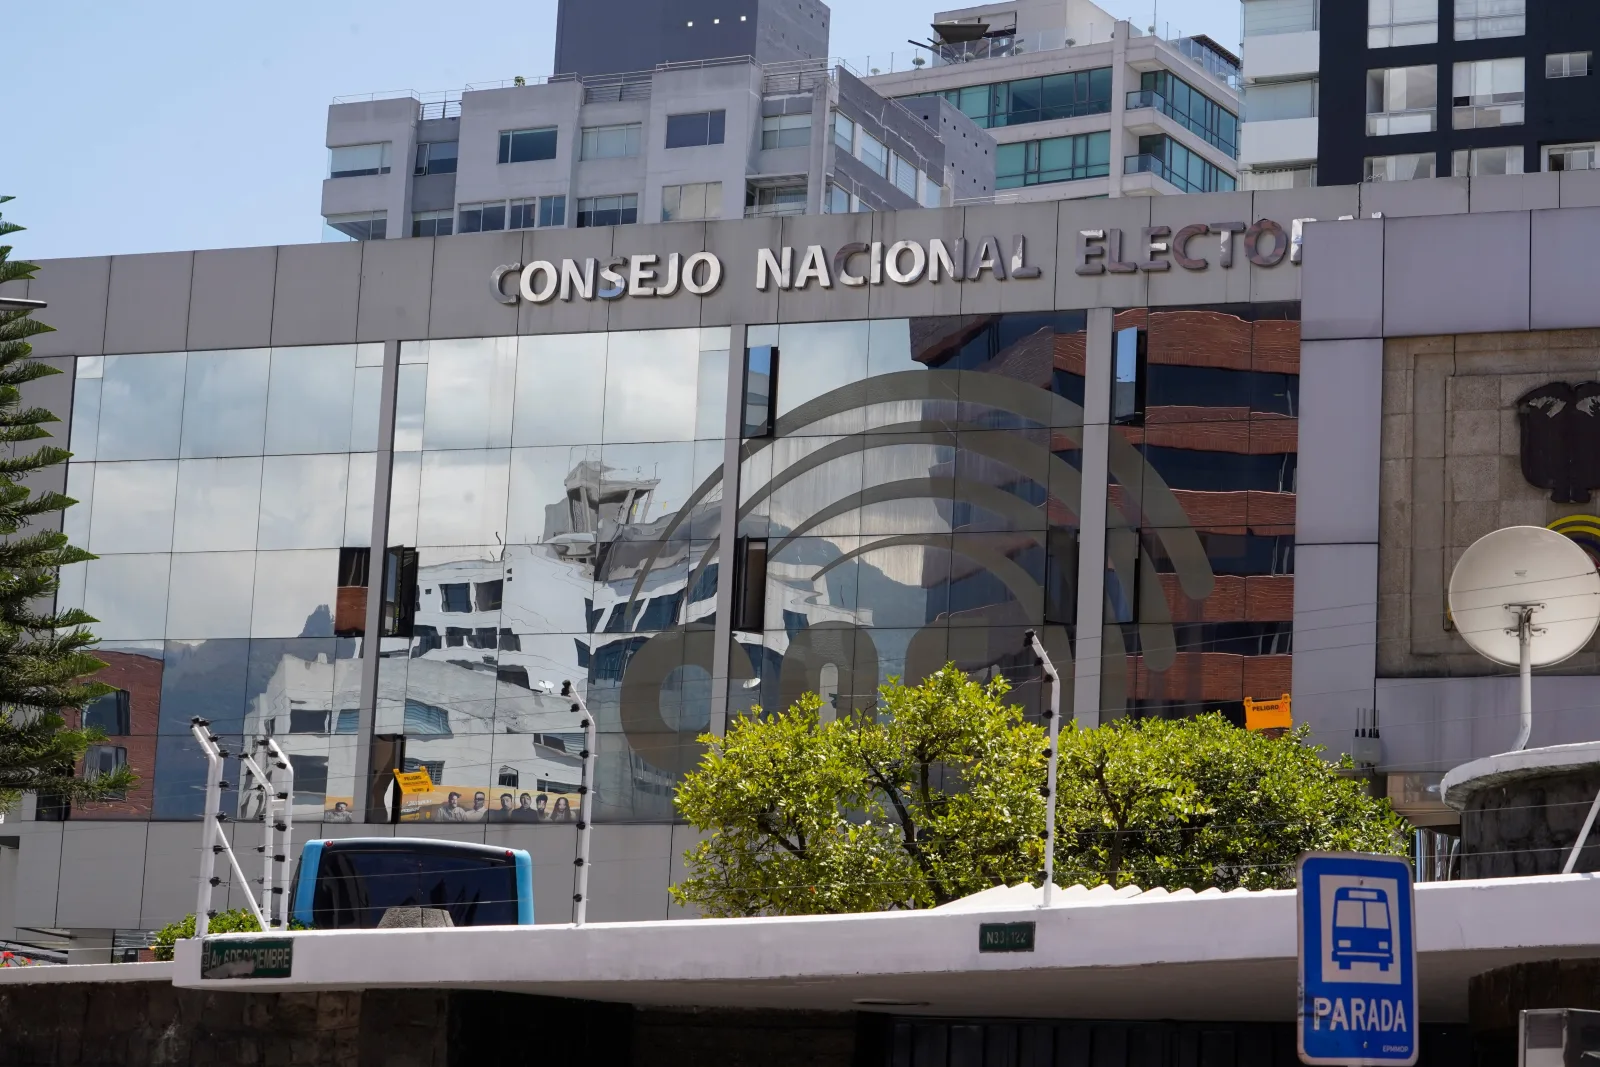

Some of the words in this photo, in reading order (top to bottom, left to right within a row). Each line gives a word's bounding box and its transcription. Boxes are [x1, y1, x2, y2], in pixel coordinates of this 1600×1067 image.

[488, 250, 723, 304] CONSEJO
[755, 233, 1041, 292] NACIONAL
[1075, 212, 1385, 276] ELECTO
[1252, 704, 1279, 712] PELIGRO
[1313, 997, 1408, 1033] PARADA
